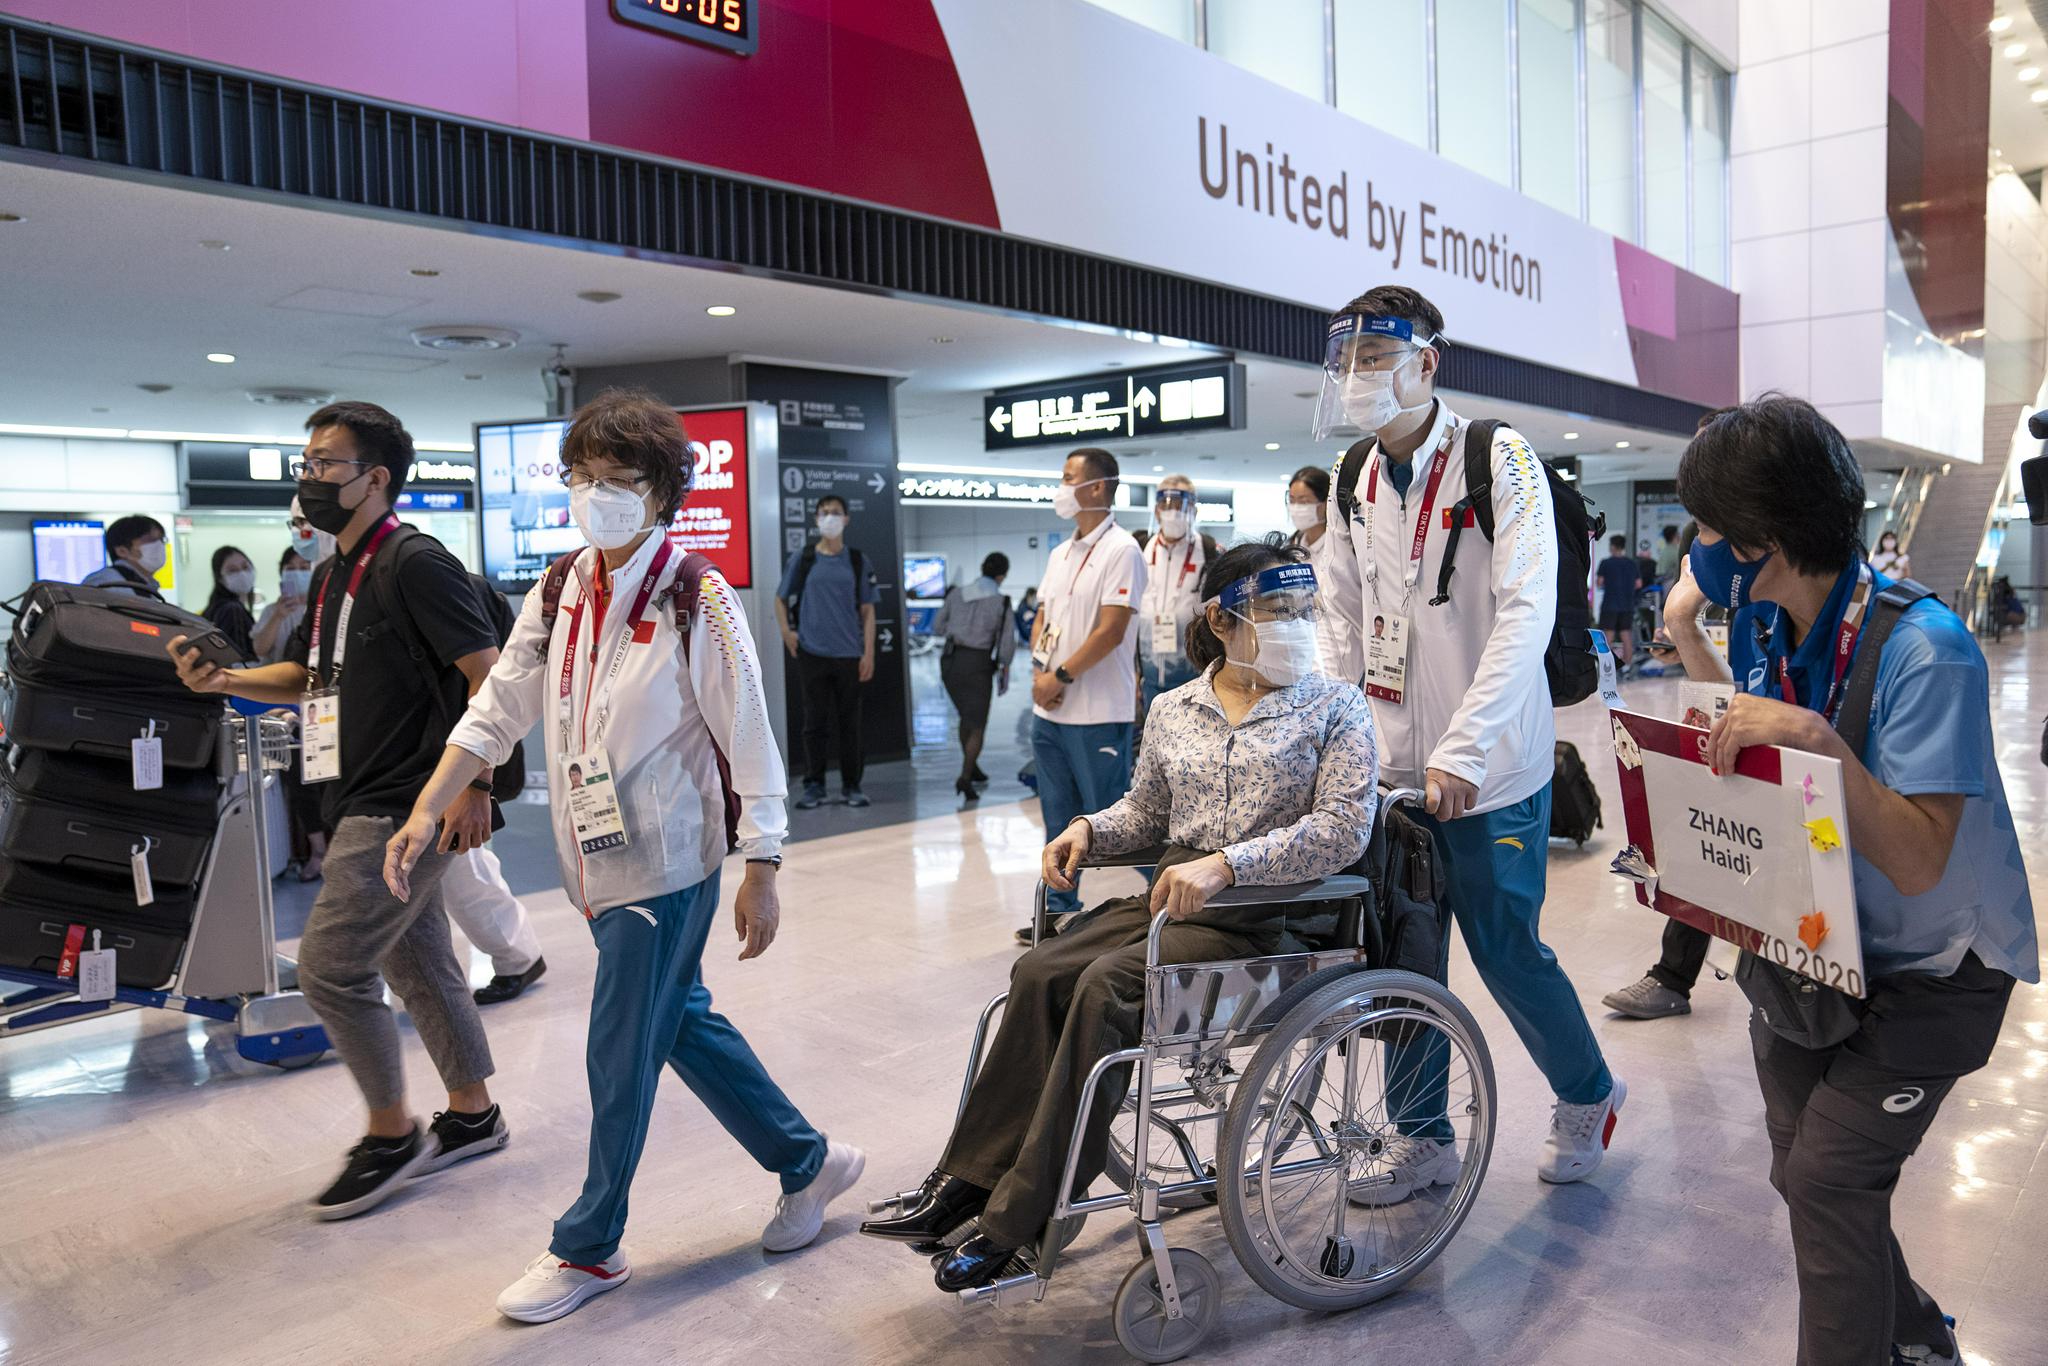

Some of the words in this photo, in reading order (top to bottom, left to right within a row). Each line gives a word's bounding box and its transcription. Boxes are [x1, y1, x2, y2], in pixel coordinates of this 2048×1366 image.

[1198, 116, 1348, 240] United
[1367, 180, 1406, 270] by
[1420, 201, 1542, 304] Emotion
[805, 470, 832, 480] Visitor
[832, 470, 860, 481] Service
[806, 480, 833, 490] Center
[1417, 510, 1430, 536] TOKYO
[1413, 535, 1424, 556] 2020
[1731, 574, 1742, 592] 2020
[609, 652, 623, 678] TOKYO
[619, 630, 631, 653] 2020
[1840, 629, 1853, 655] Atos
[564, 643, 575, 671] TOKYO
[561, 671, 571, 692] 2020
[1602, 690, 1618, 700] CHN
[1688, 807, 1763, 850] ZHANG
[1701, 839, 1751, 876] Haidi
[60, 959, 71, 973] VIP
[1709, 912, 1789, 967] TOKYO
[1796, 947, 1862, 998] 2020
